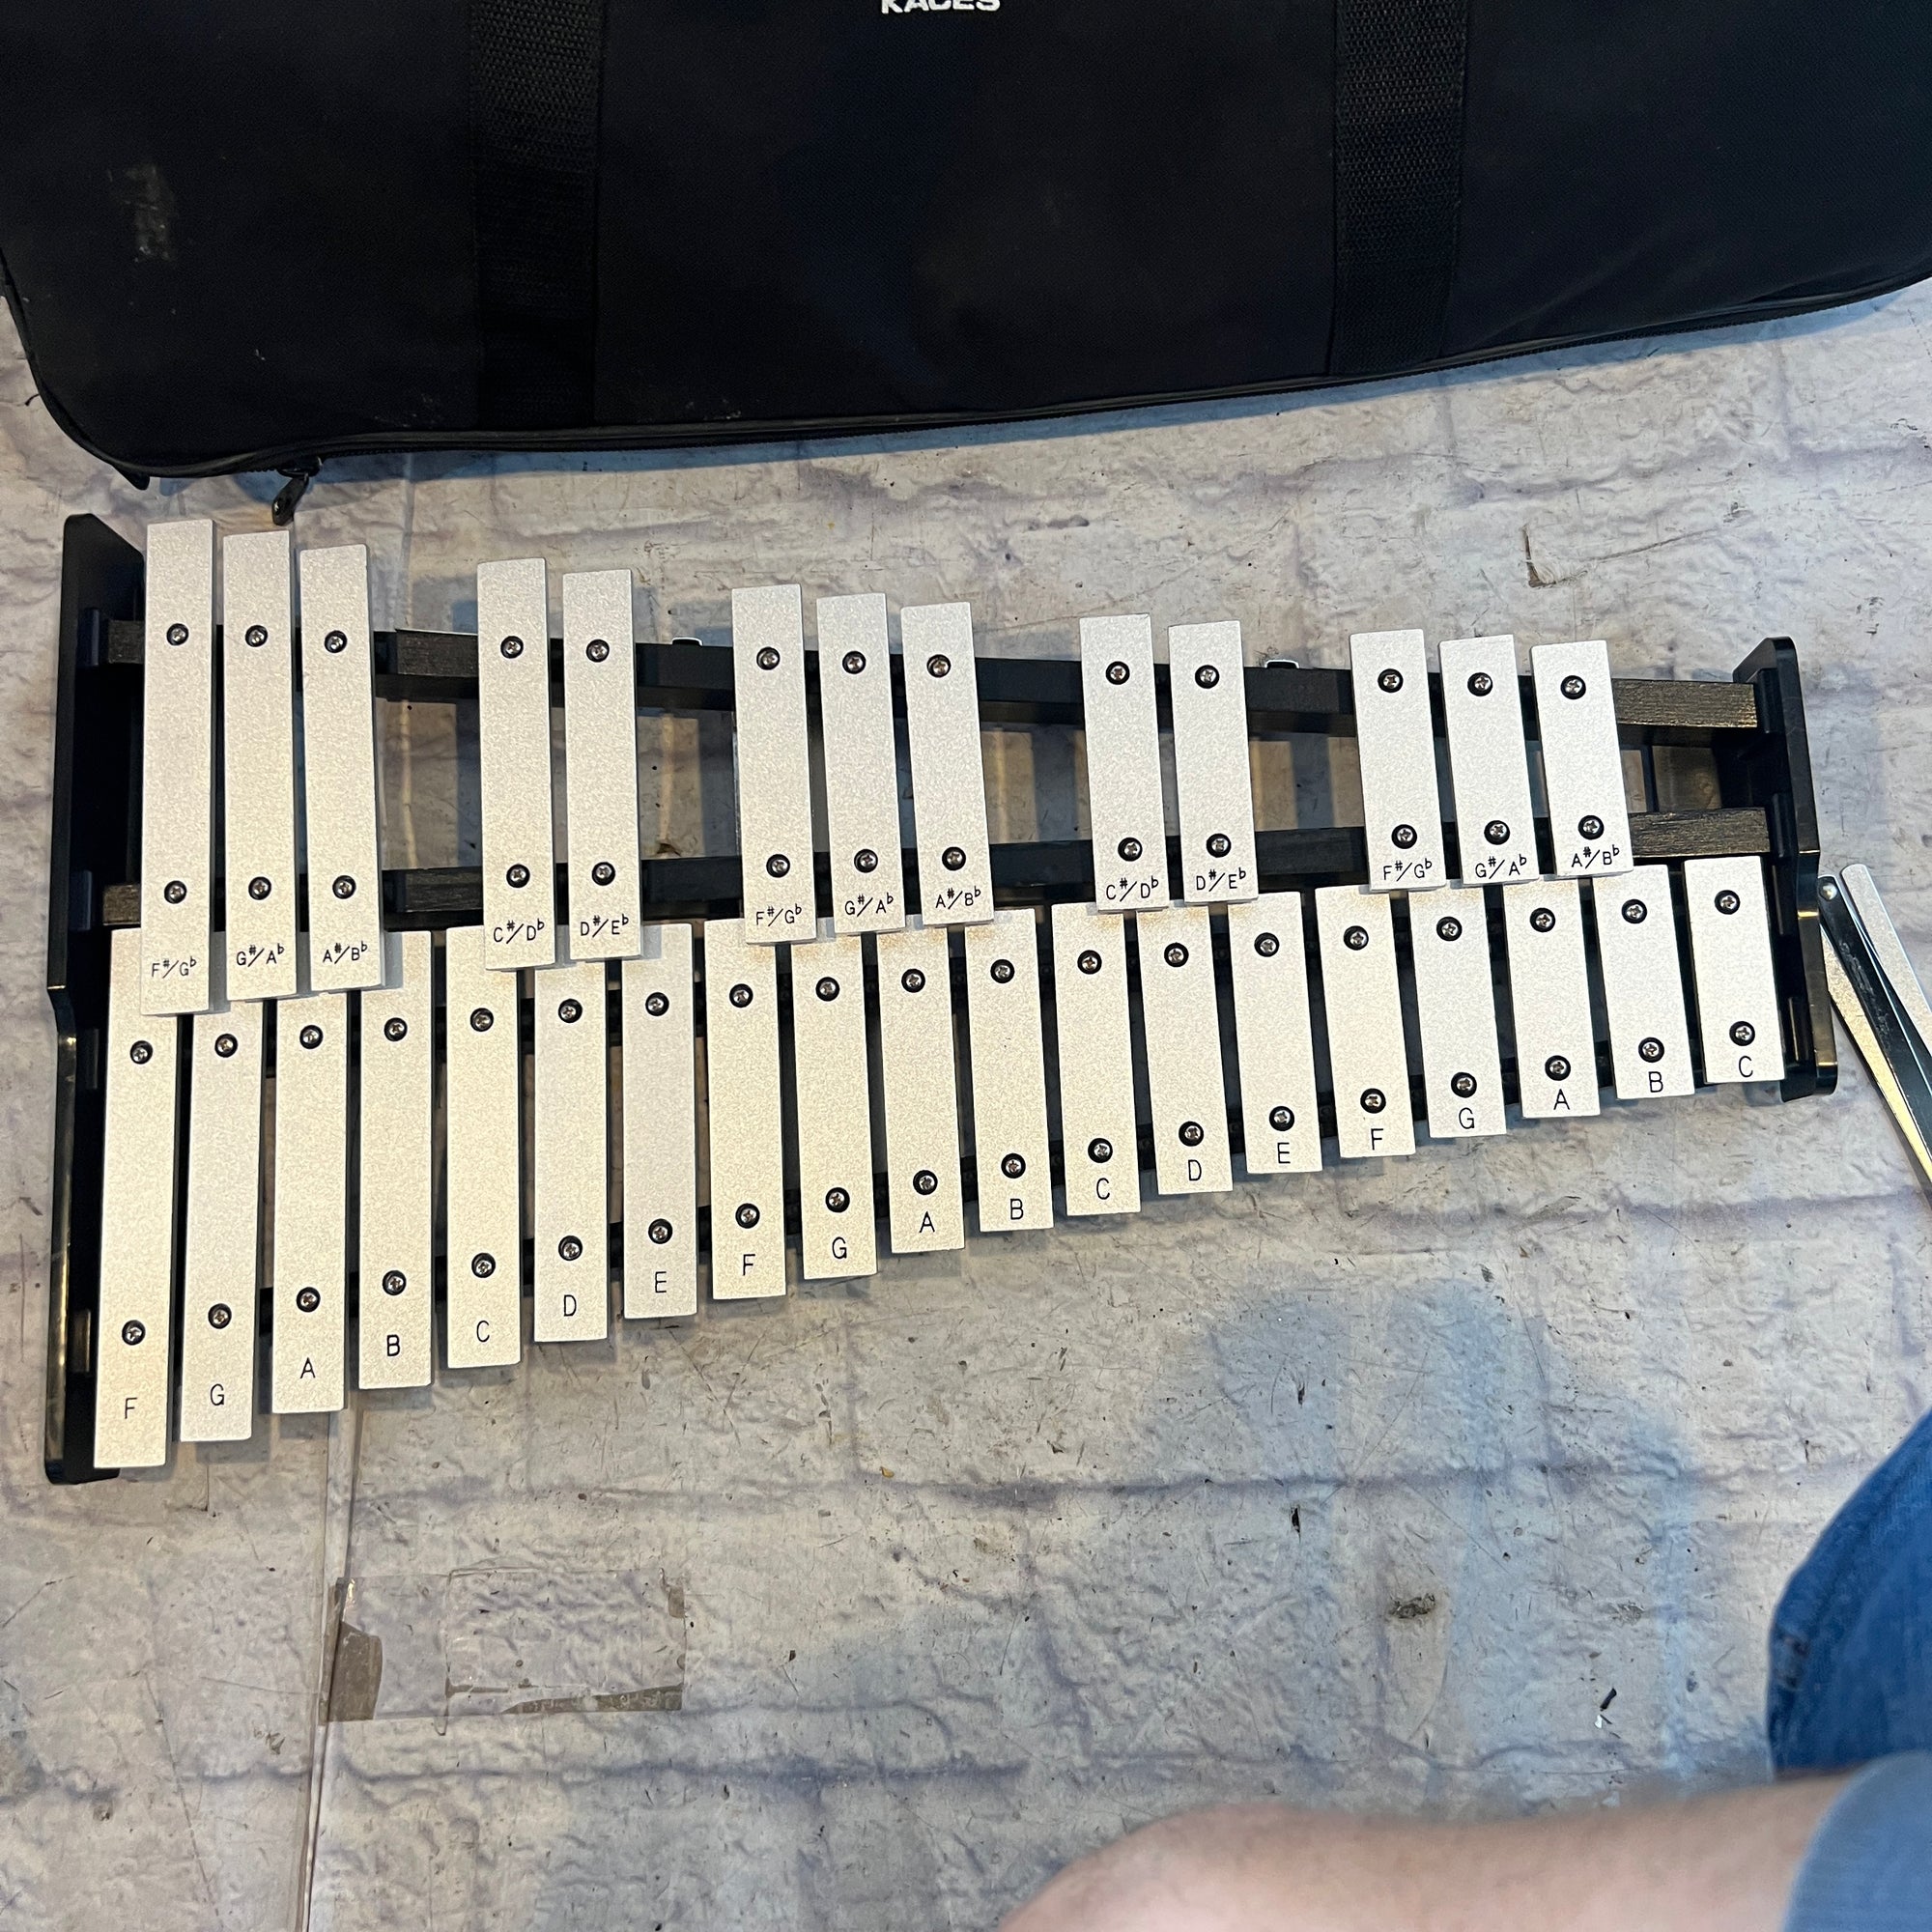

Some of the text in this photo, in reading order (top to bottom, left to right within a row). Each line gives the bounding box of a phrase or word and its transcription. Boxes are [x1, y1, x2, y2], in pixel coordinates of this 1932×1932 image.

[1738, 1055, 1754, 1079] C
[1647, 1070, 1664, 1094] B
[1552, 1088, 1571, 1111] A
[1458, 1106, 1476, 1130] G
[1370, 1127, 1384, 1151] F
[1276, 1141, 1292, 1165] E
[1187, 1158, 1203, 1182] D
[1095, 1177, 1111, 1201] C
[1009, 1197, 1025, 1221] B
[918, 1210, 936, 1234] A
[831, 1236, 848, 1261] G
[742, 1253, 756, 1277] F
[654, 1270, 668, 1294] E
[562, 1293, 578, 1318] D
[475, 1320, 491, 1344] C
[385, 1333, 401, 1357] B
[298, 1356, 317, 1379] A
[210, 1382, 225, 1406] G
[124, 1396, 138, 1420] F
